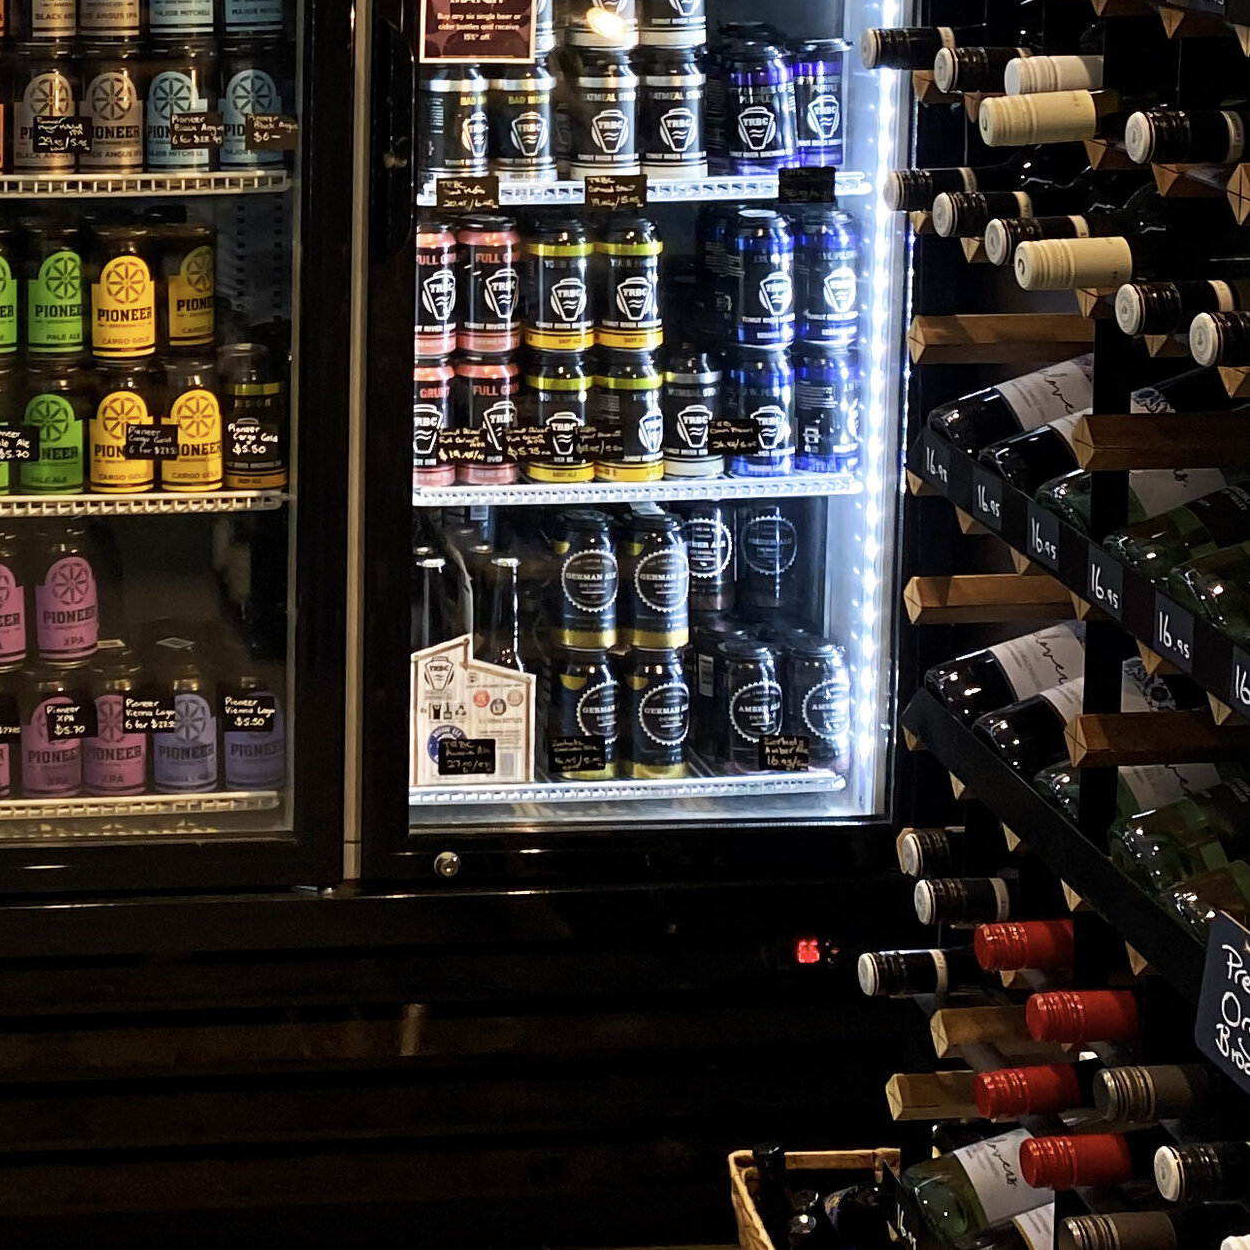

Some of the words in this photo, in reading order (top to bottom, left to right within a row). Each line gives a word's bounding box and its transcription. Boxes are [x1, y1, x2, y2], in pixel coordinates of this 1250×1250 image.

[598, 120, 623, 129] TRBC
[666, 119, 691, 129] TRBC
[557, 288, 582, 297] TRBC
[623, 287, 648, 297] TRBC
[63, 637, 85, 646] XPA
